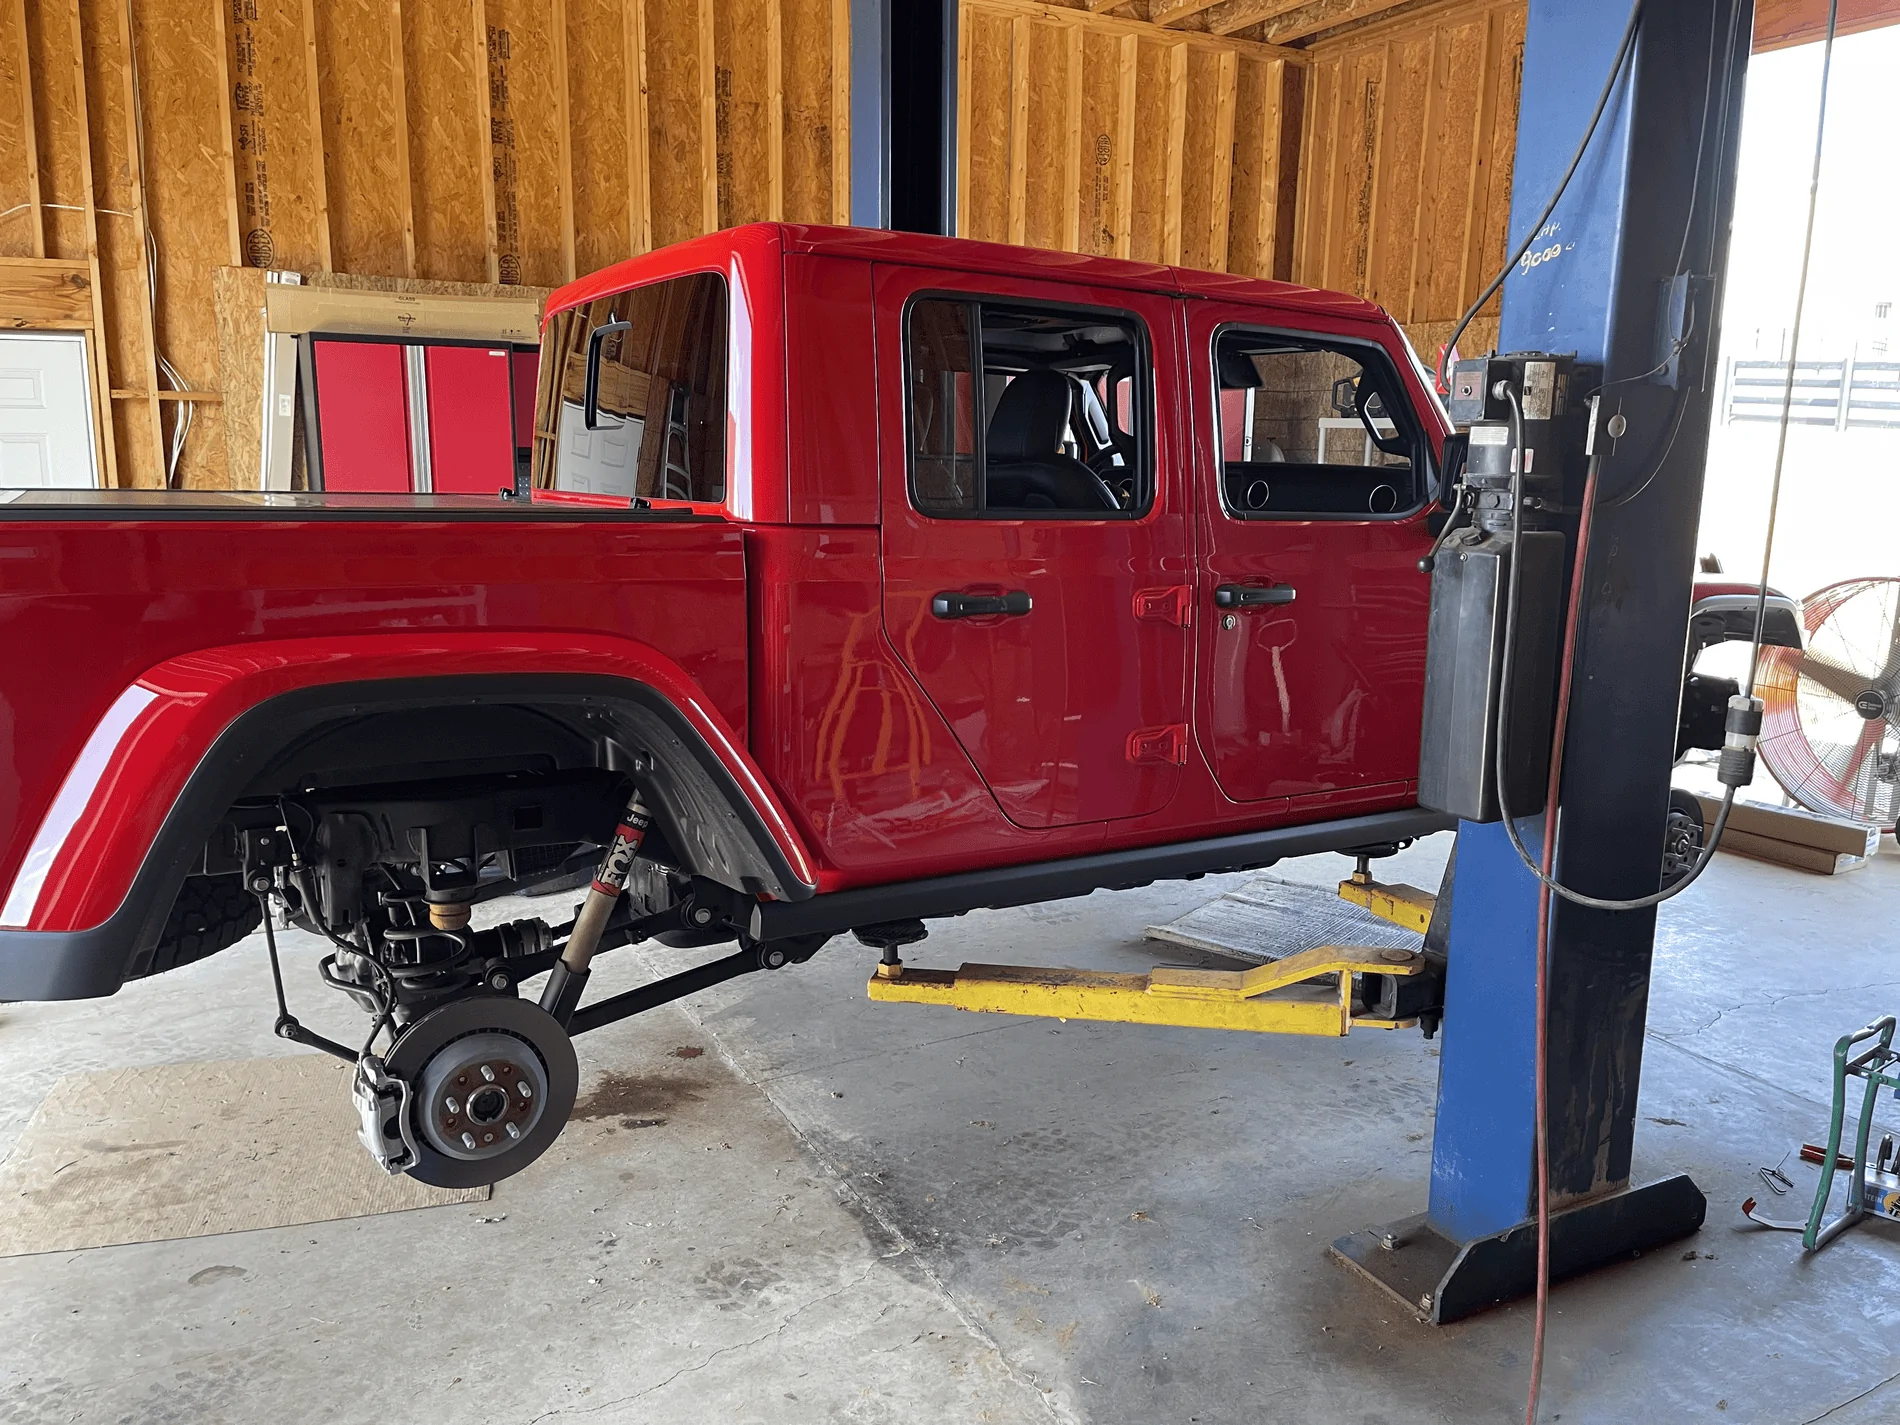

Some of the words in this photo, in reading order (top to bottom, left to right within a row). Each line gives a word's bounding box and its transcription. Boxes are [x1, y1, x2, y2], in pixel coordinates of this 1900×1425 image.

[249, 232, 273, 267] HUBER
[1520, 243, 1562, 276] 9000
[626, 813, 649, 829] Jeep
[600, 834, 639, 888] FOX
